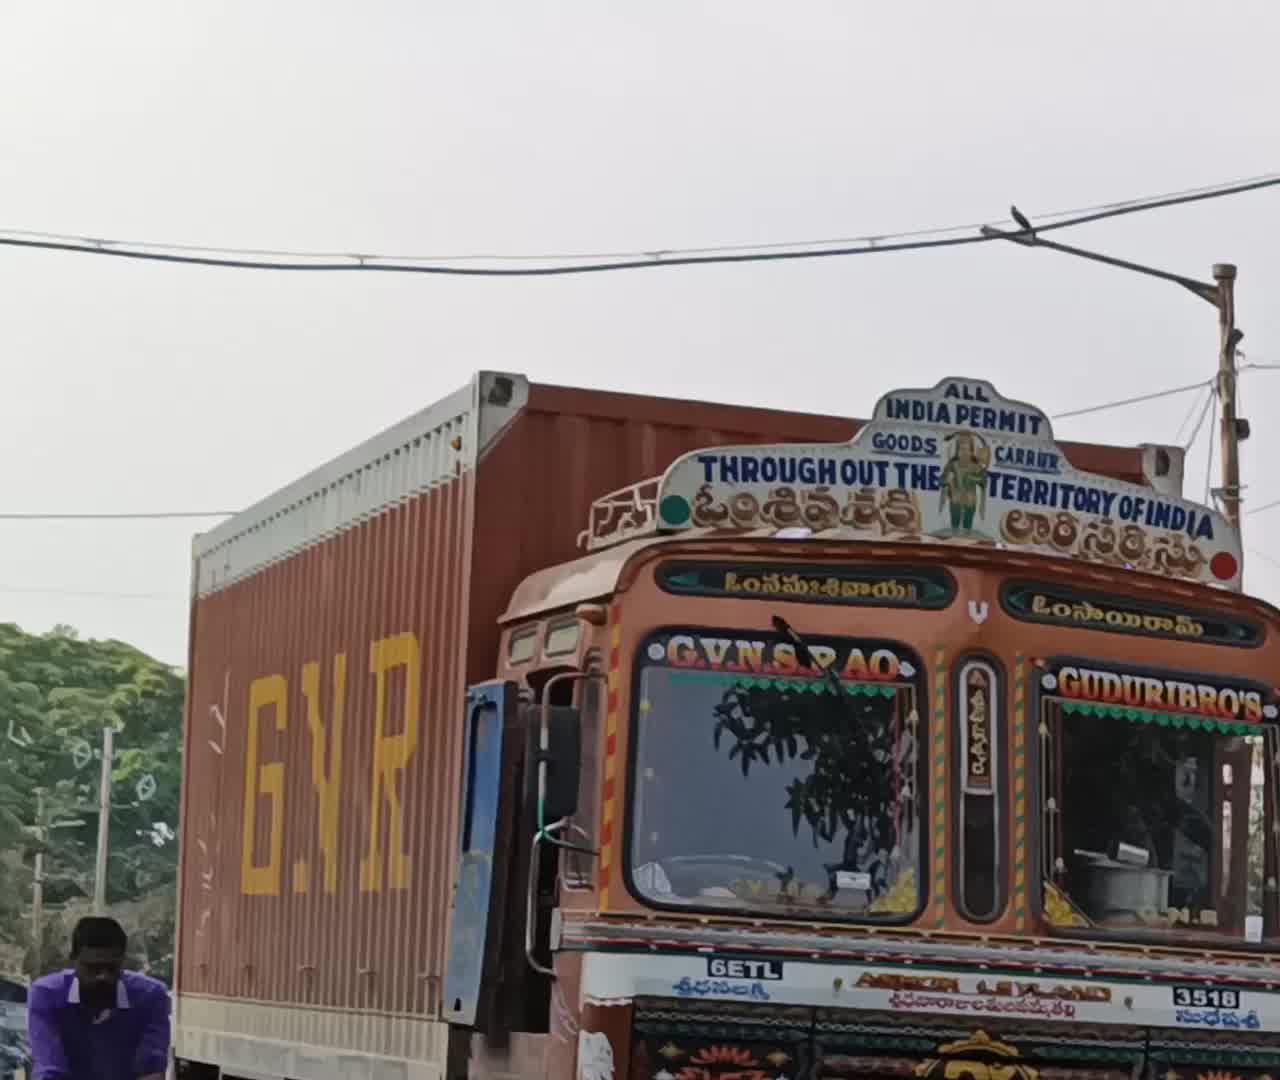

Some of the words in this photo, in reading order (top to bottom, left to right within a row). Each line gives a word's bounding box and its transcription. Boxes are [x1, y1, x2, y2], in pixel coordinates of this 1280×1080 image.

[945, 383, 989, 401] ALL
[886, 398, 950, 424] INDIA
[956, 403, 1041, 435] PERMIT
[872, 432, 937, 454] GOODS
[699, 456, 836, 485] THROUGH
[841, 461, 889, 488] OUT
[894, 464, 941, 491] THE
[987, 471, 1116, 516] TERRITORY
[1119, 496, 1144, 522] OF
[1148, 501, 1214, 541] INDIA
[710, 960, 779, 978] 6ETL
[1176, 989, 1237, 1007] 3518
